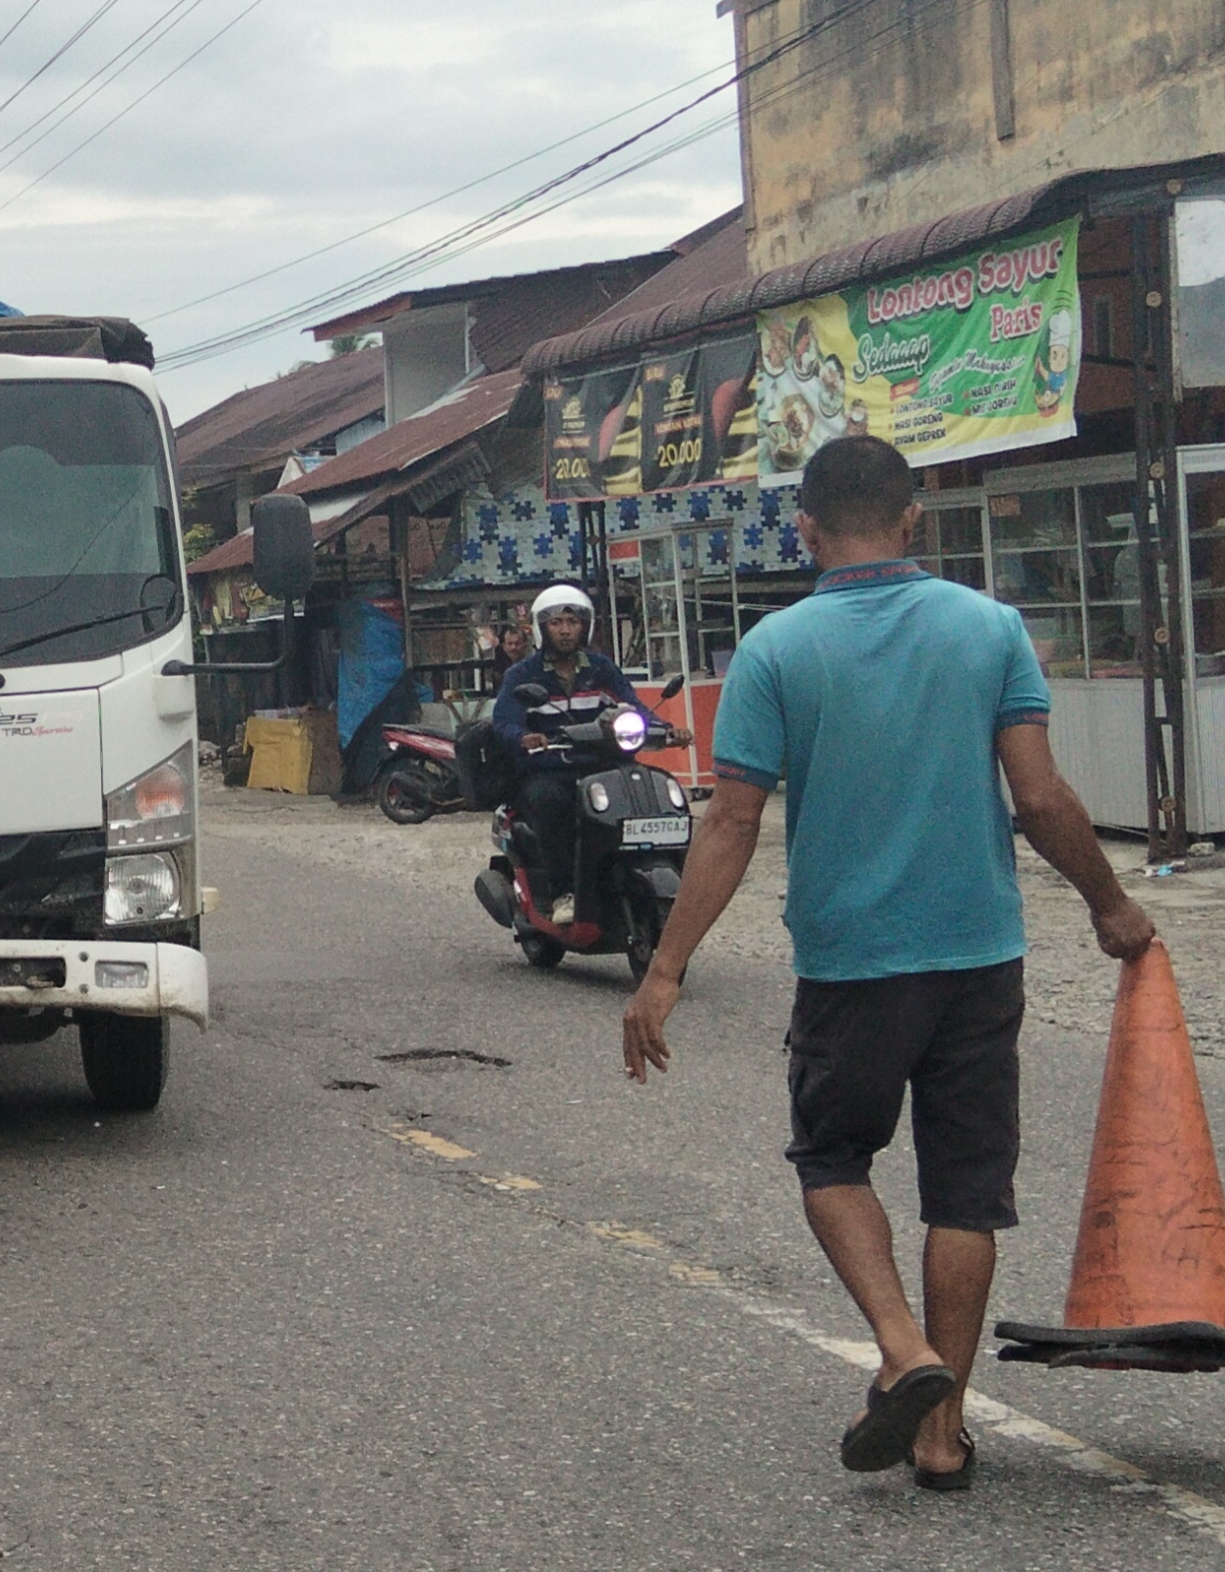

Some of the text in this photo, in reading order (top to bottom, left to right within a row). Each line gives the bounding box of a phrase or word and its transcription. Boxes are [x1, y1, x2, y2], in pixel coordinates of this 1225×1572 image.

[867, 237, 1063, 324] Lontong Sayur
[989, 297, 1043, 342] Paris
[970, 385, 992, 398] NASI
[928, 393, 954, 408] SAYUR
[894, 411, 944, 431] NASI GORENG
[917, 428, 947, 443] GEPREK
[1, 726, 33, 737] TRD
[625, 823, 639, 835] BL
